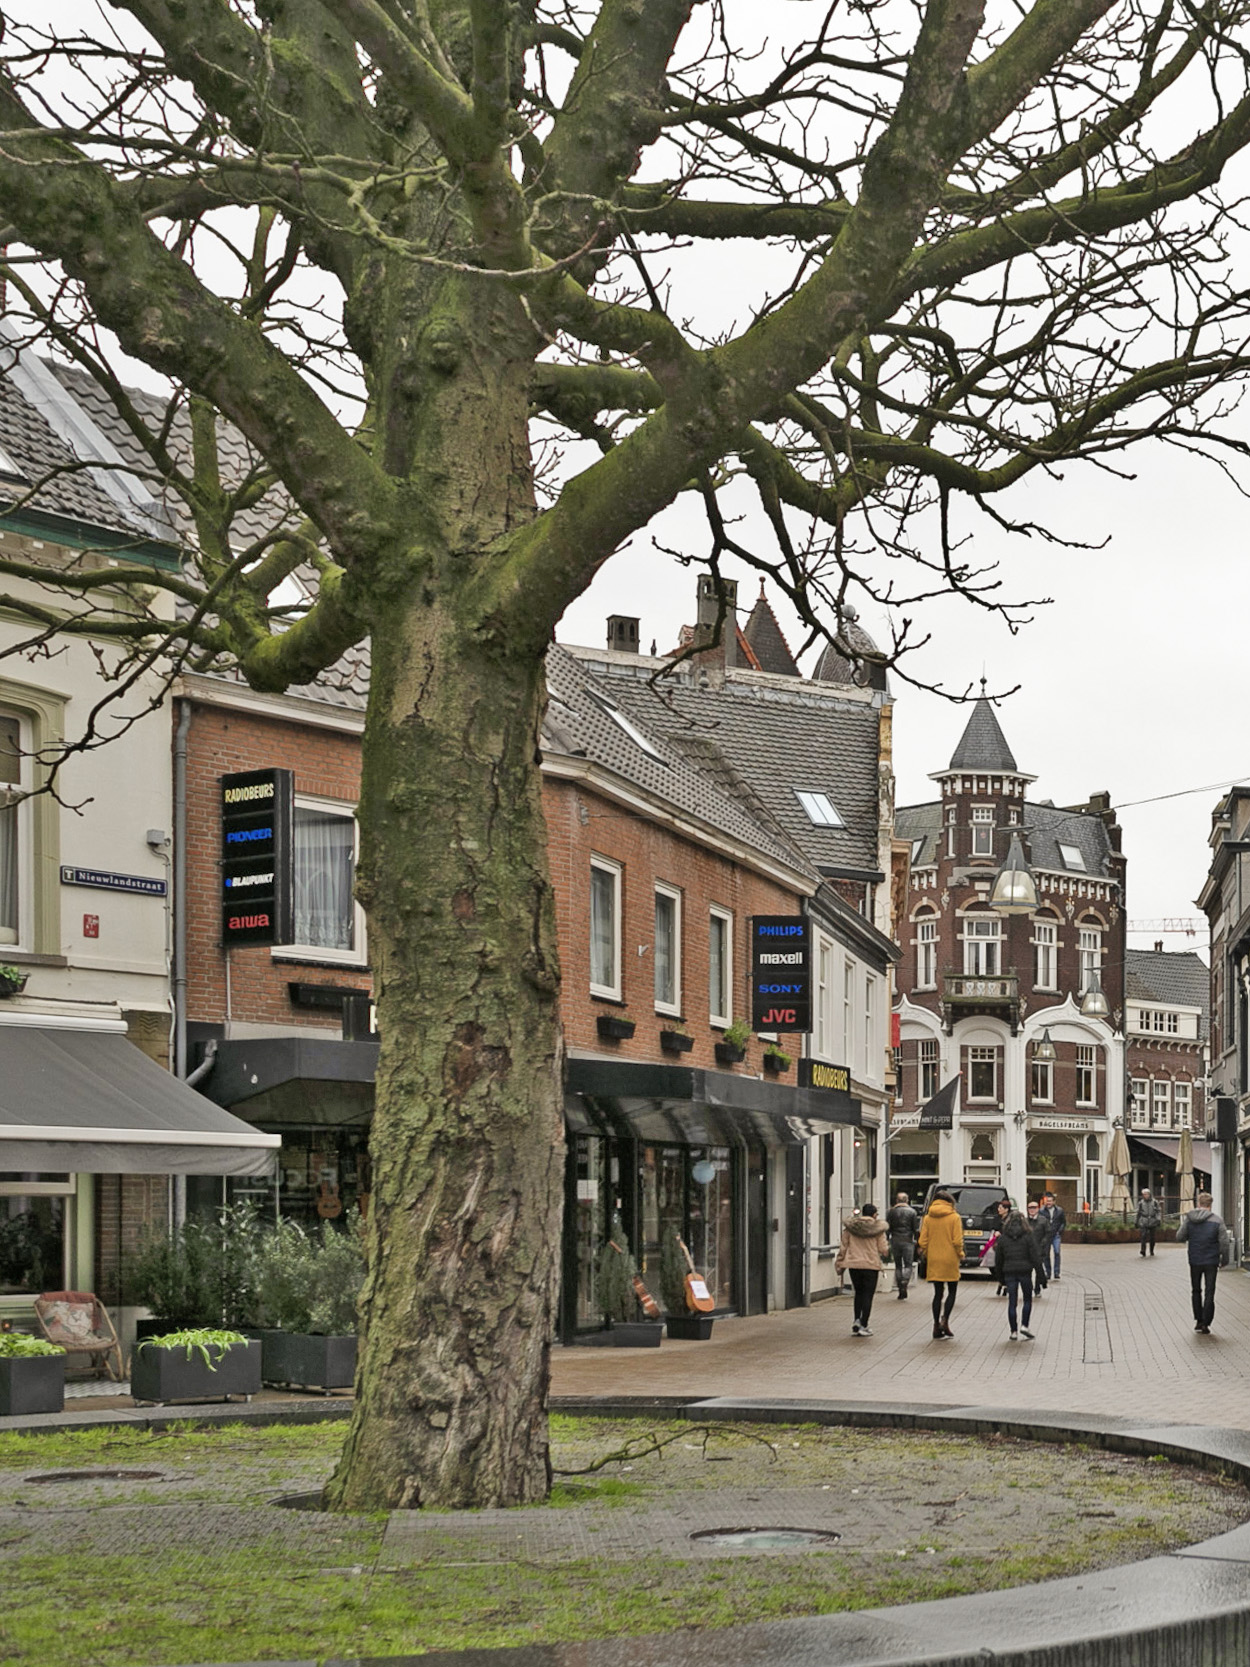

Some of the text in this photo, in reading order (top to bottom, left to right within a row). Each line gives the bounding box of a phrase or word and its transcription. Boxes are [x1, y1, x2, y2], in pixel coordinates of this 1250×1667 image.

[225, 782, 274, 803] RADIOBEURS
[227, 828, 272, 843] PIONEER
[79, 872, 162, 891] Nieuwlandstraat
[232, 873, 274, 887] BLAUPUNKT
[228, 914, 270, 929] aiwa
[758, 925, 803, 937] PHILIPS
[759, 952, 803, 965] maxell
[758, 984, 802, 993] SONY
[761, 1009, 796, 1023] JVC
[812, 1064, 848, 1091] RADIOBEURS
[1006, 1163, 1012, 1171] 2
